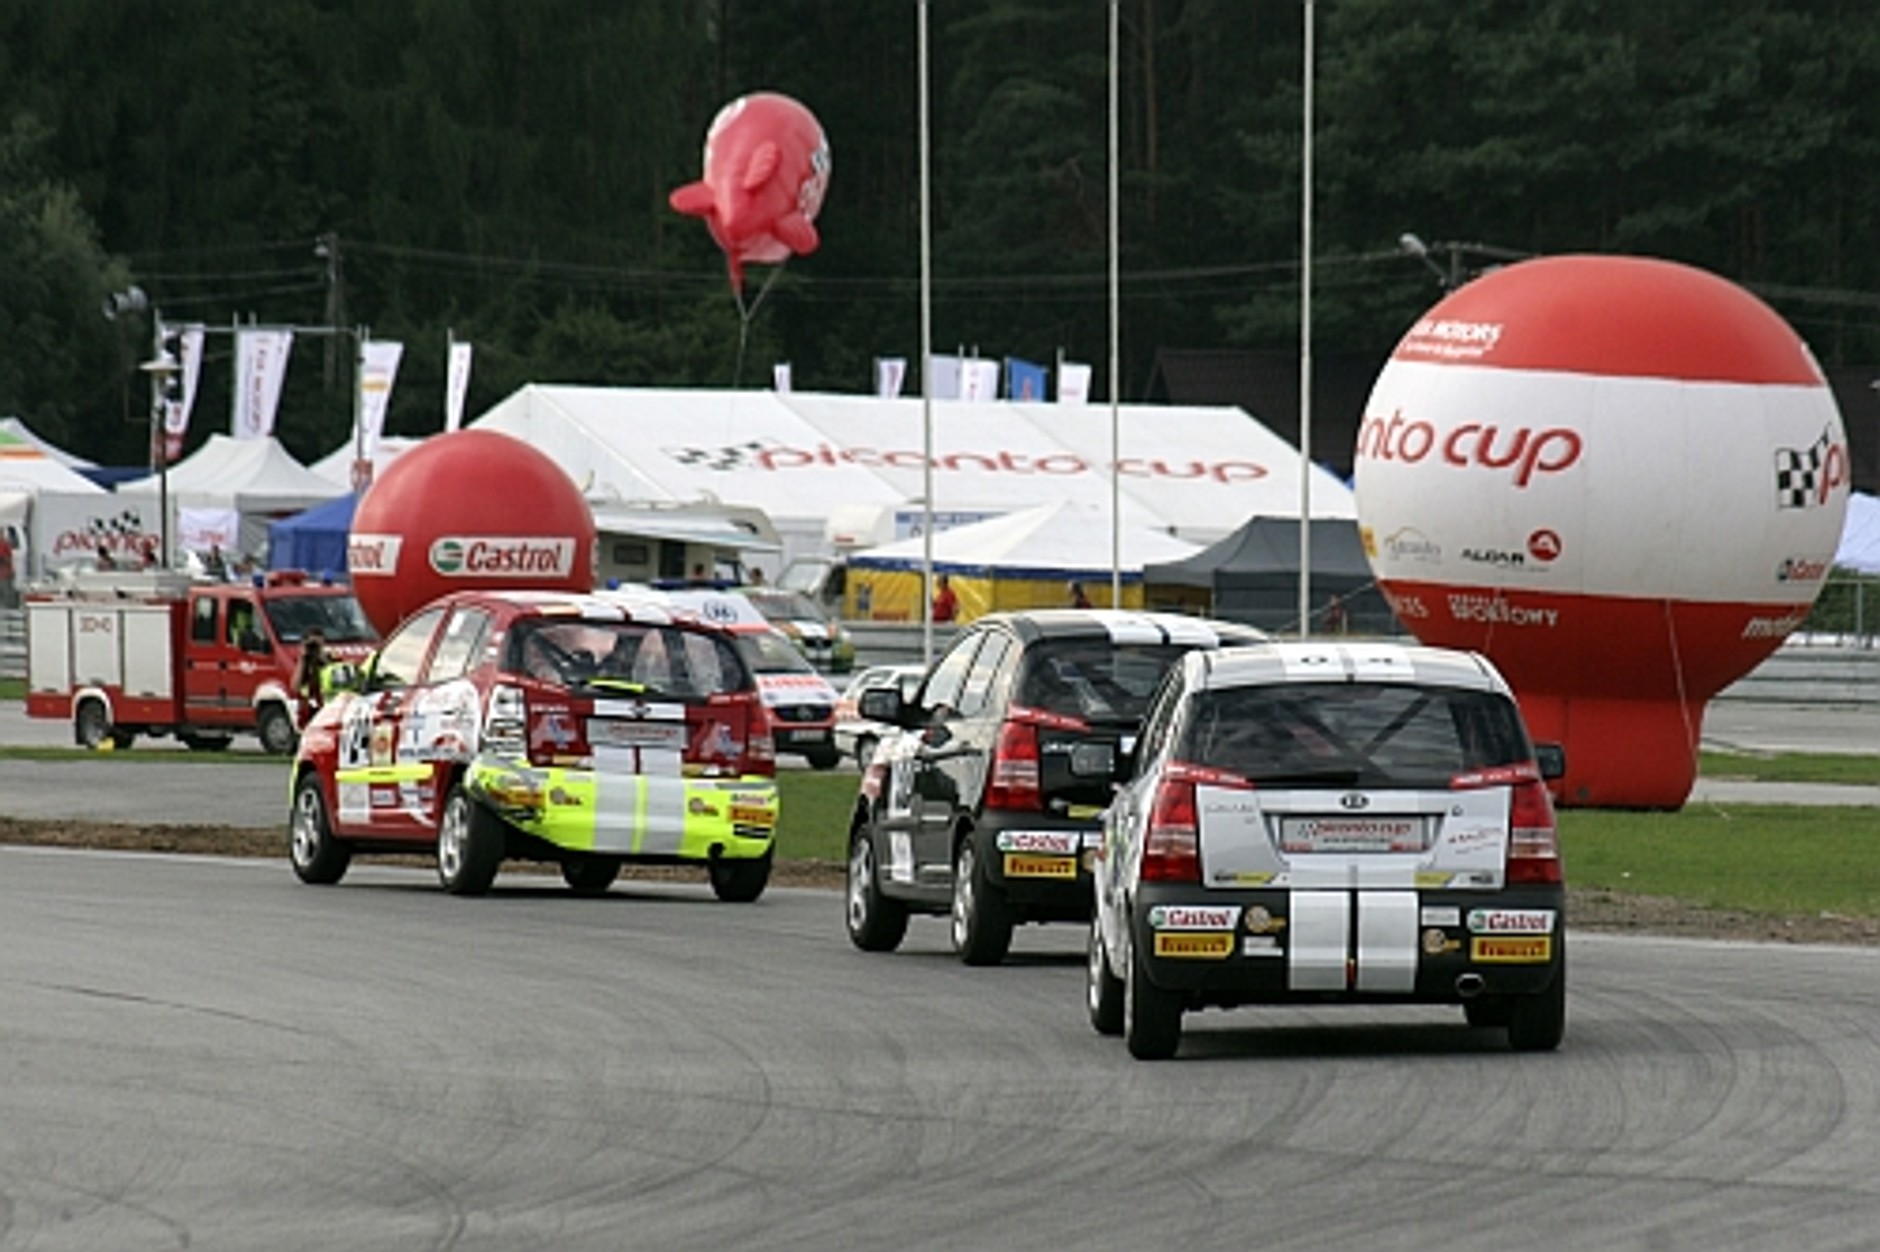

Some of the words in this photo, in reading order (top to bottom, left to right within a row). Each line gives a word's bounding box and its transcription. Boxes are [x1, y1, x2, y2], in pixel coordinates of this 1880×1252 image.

[756, 443, 1087, 473] picanto
[1113, 457, 1269, 484] cup
[1444, 423, 1582, 487] cup
[466, 541, 563, 573] Castrol
[1168, 909, 1232, 927] Castrol
[1487, 912, 1548, 930] Castrol
